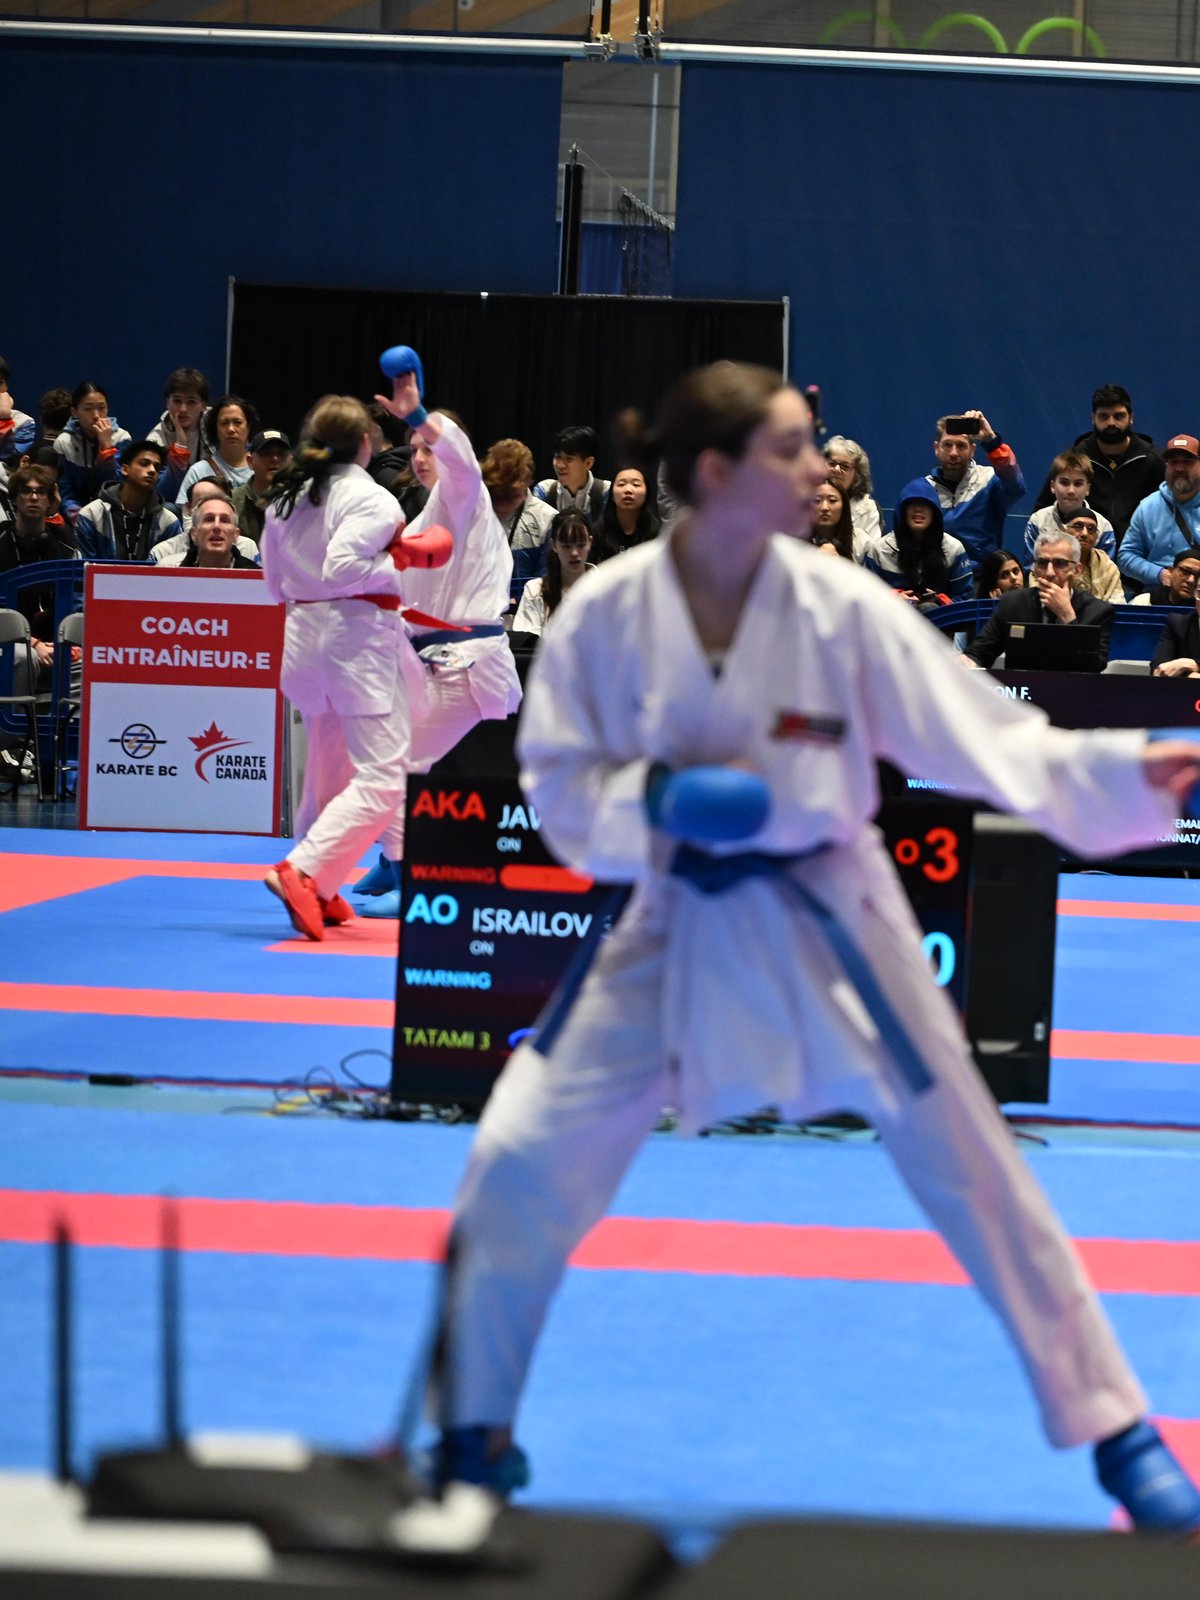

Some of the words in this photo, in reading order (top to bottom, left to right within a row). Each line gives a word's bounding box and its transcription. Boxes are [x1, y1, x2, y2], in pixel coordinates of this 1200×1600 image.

[141, 617, 229, 637] COACH
[1020, 686, 1032, 701] F.
[96, 763, 154, 776] KARATE
[158, 765, 178, 777] BC
[216, 754, 266, 768] KARATE
[215, 768, 267, 781] CANADA
[411, 790, 487, 821] AKA
[496, 837, 522, 852] ON
[411, 864, 497, 884] WARNING
[405, 893, 459, 925] AO
[472, 907, 593, 938] ISRAILOV
[469, 939, 495, 956] ON
[404, 967, 492, 990] WARNING
[403, 1026, 474, 1050] TATAMI
[479, 1031, 491, 1051] 3
